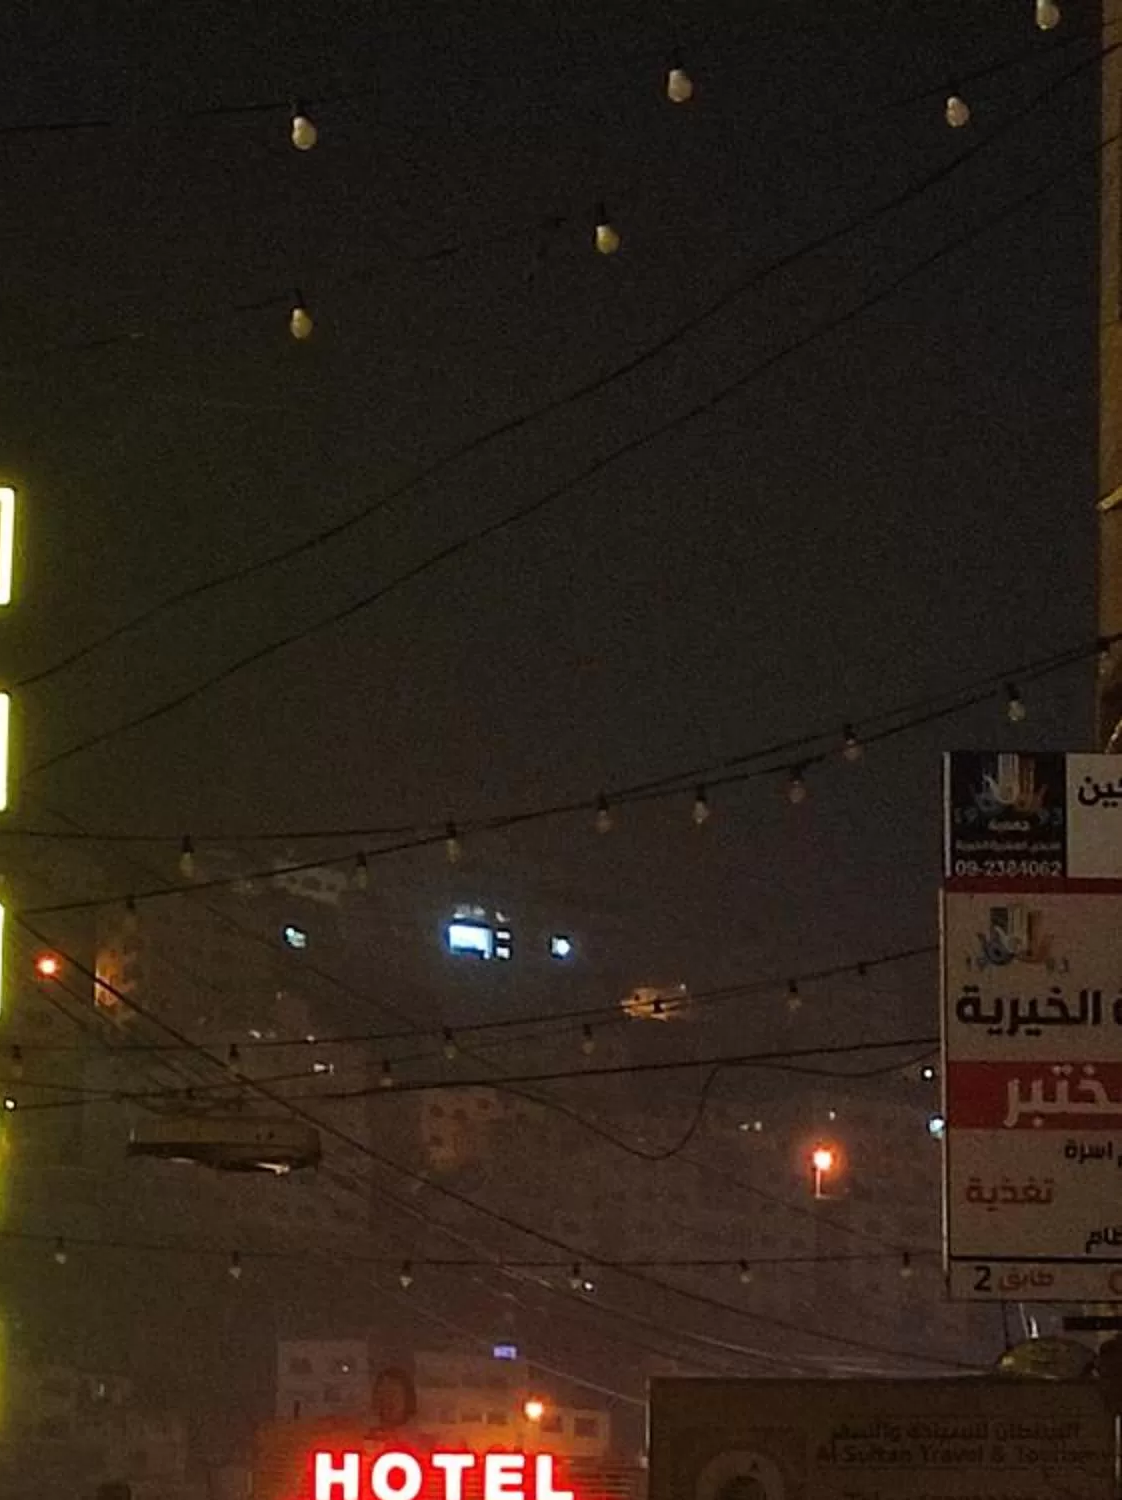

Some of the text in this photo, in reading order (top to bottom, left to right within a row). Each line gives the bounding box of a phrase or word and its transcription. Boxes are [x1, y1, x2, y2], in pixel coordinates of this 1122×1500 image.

[955, 986, 1102, 1036] الخيرية
[1002, 1062, 1122, 1129] ختبر
[973, 1265, 992, 1291] 2
